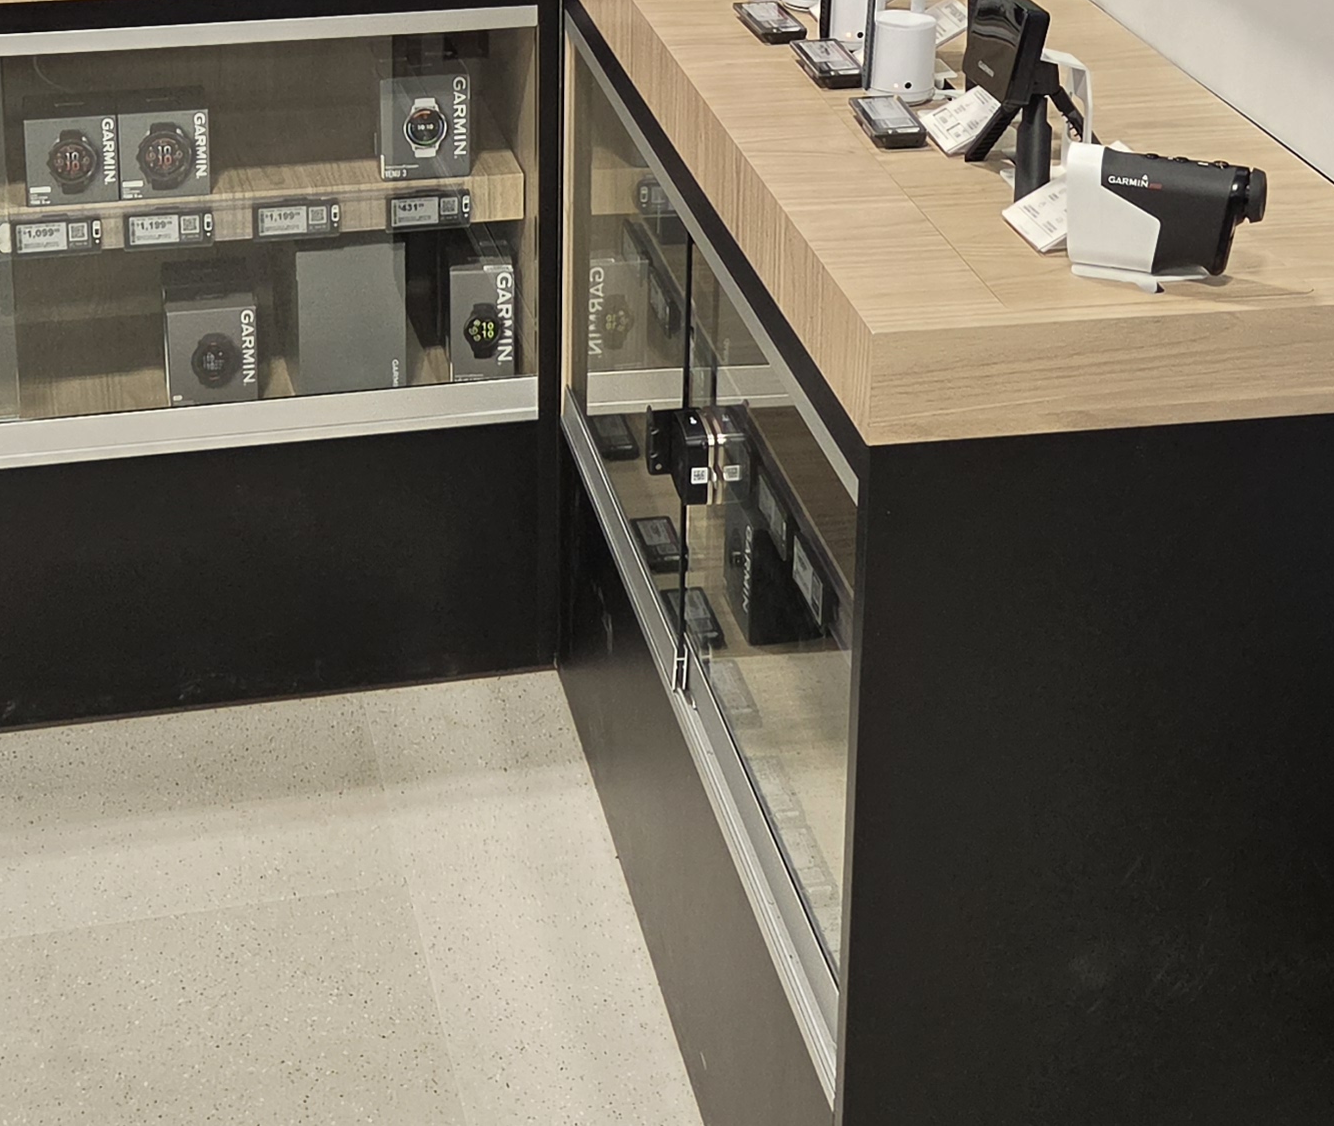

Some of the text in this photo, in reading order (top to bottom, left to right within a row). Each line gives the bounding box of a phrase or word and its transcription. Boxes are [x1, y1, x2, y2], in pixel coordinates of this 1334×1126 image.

[193, 112, 208, 176] GARMIN
[453, 76, 466, 155] GARMIN
[101, 117, 116, 183] GARMIN
[1108, 174, 1149, 188] GARMIN
[241, 309, 256, 383] GARMIN
[481, 330, 495, 338] 10
[496, 272, 513, 361] GARMIN
